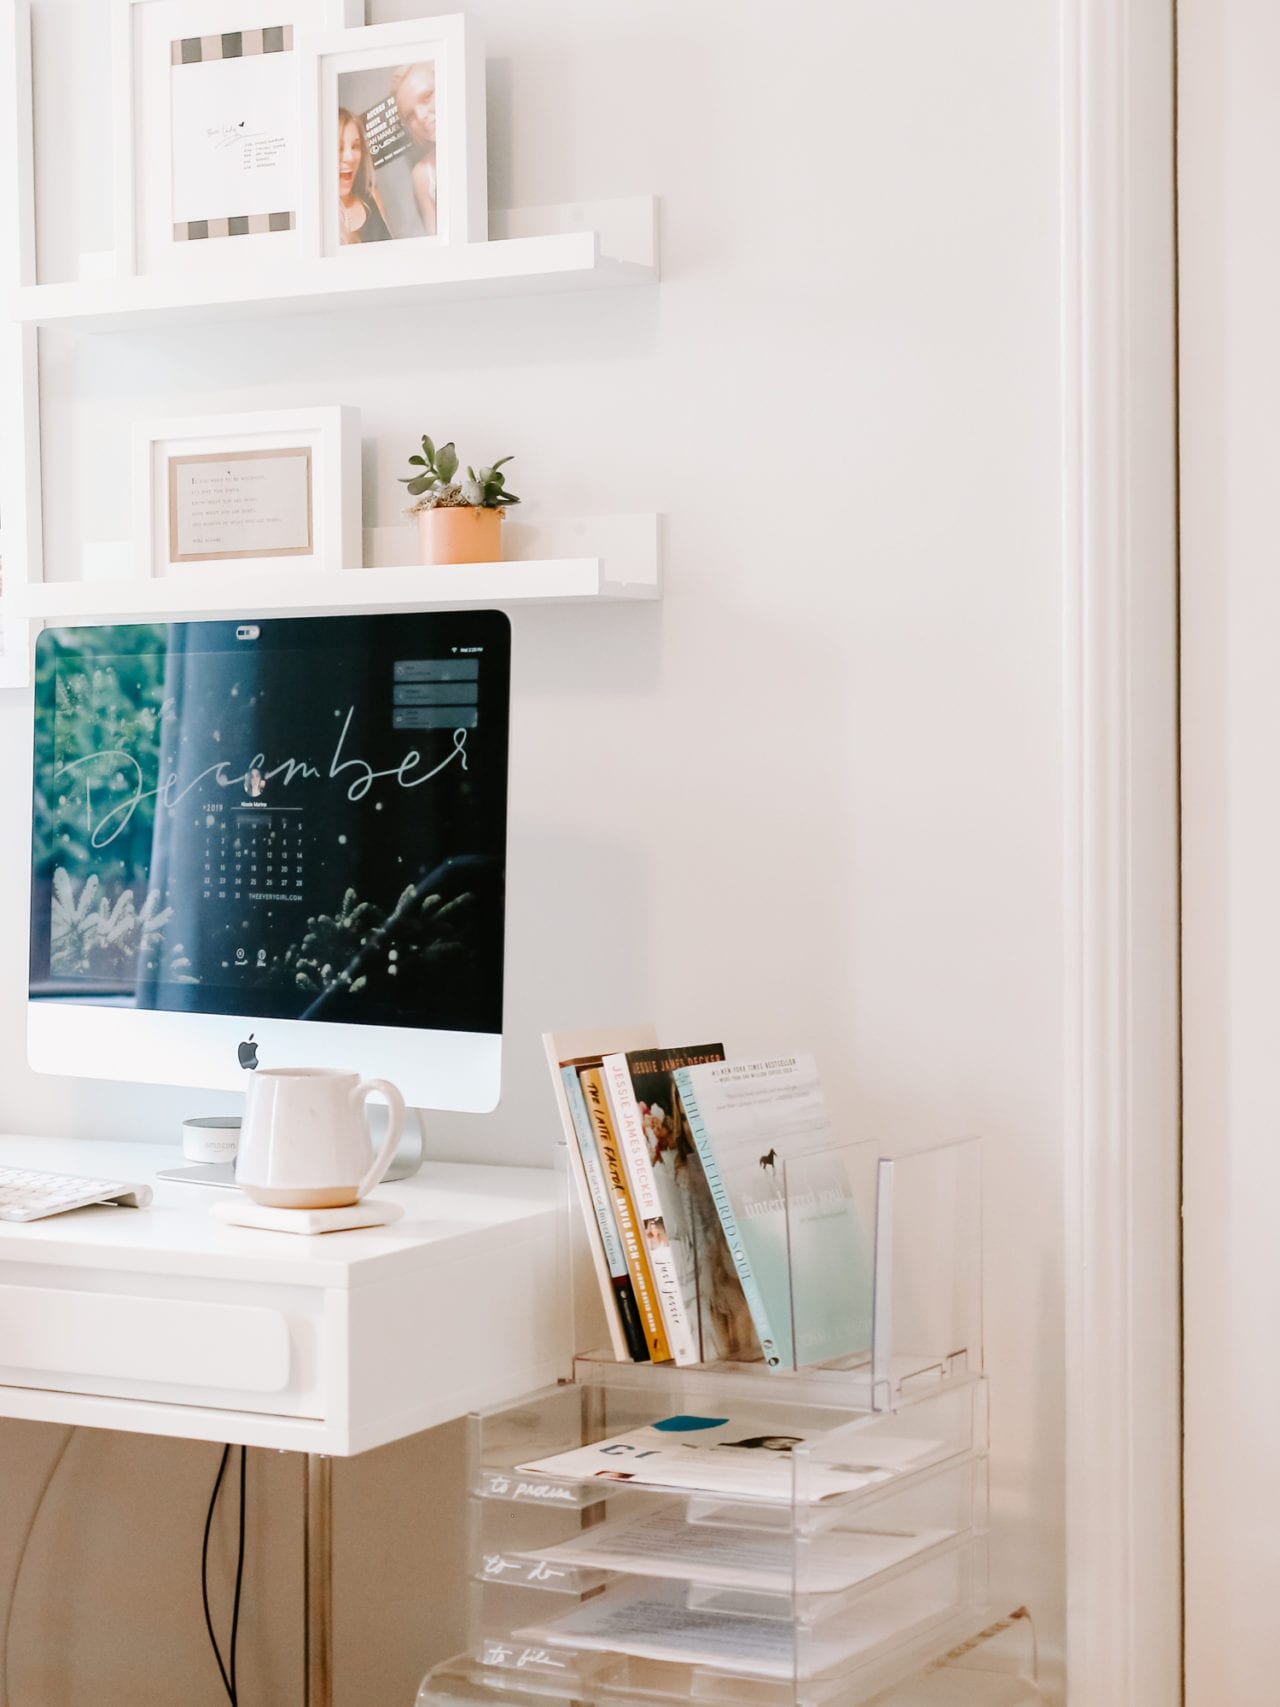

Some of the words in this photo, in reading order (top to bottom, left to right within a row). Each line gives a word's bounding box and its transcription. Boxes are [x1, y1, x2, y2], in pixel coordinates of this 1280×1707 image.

[54, 706, 468, 848] December
[206, 804, 223, 812] 2019
[249, 893, 302, 901] THEEVERYGIRL.COM
[720, 1068, 732, 1076] NEW
[733, 1066, 746, 1074] YORK
[748, 1063, 763, 1072] TIMES
[765, 1058, 796, 1070] BESTSELLER
[587, 1082, 600, 1104] THE
[593, 1109, 612, 1141] LATTE
[612, 1065, 631, 1107] JESSIE
[623, 1113, 641, 1154] JAMES
[634, 1158, 653, 1208] DECKER
[603, 1146, 625, 1191] FACTOR
[616, 1198, 632, 1229] DAVID
[694, 1127, 736, 1237] UNTETHERED
[731, 1240, 751, 1280] SOUL
[625, 1231, 640, 1260] BACH
[489, 1476, 511, 1494] to
[484, 1555, 521, 1574] to
[528, 1561, 565, 1580] do
[488, 1646, 513, 1664] to
[517, 1647, 565, 1668] file
